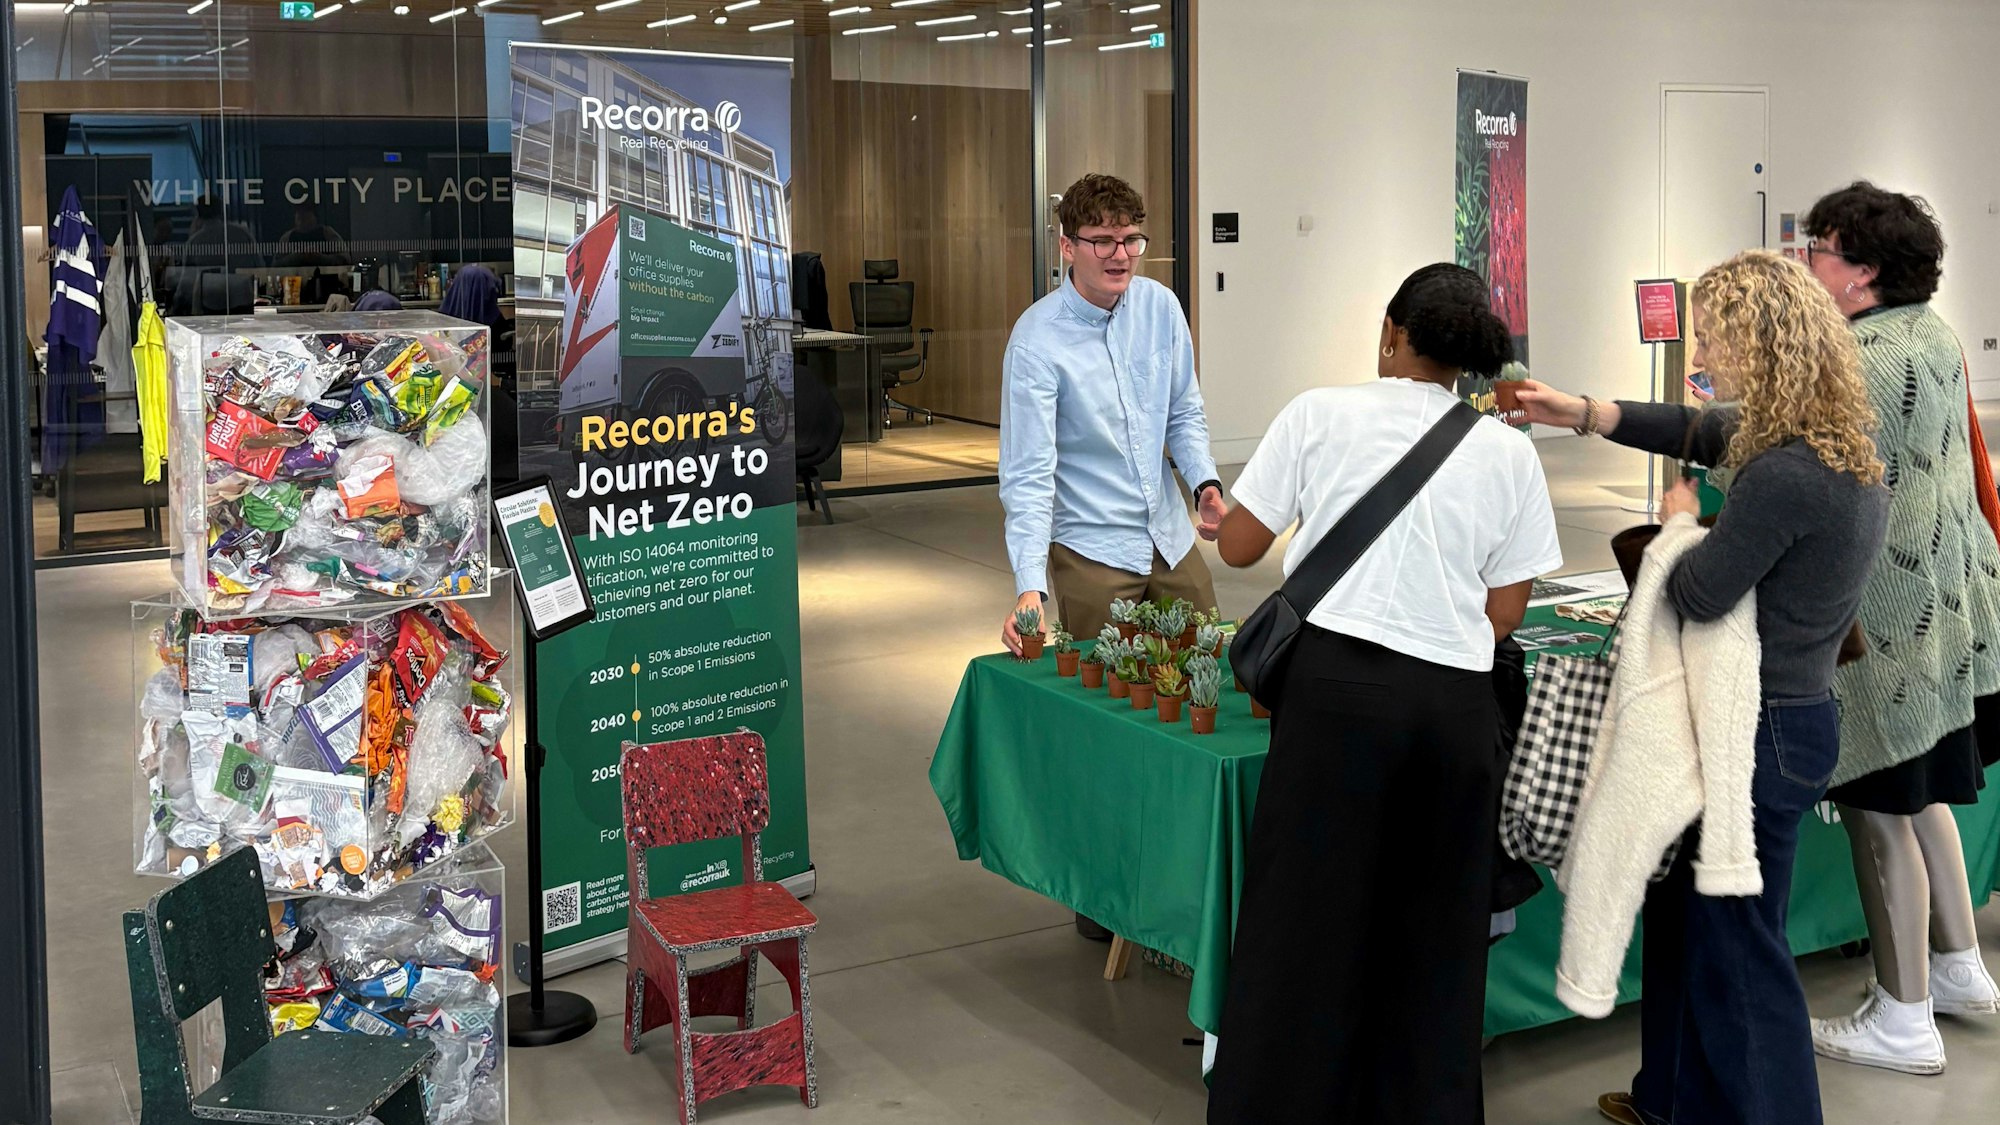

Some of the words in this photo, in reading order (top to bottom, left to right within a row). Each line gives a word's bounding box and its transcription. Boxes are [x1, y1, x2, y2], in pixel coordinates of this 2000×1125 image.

[581, 96, 709, 131] Recorra
[1475, 108, 1509, 135] Recorra
[620, 135, 645, 148] Real
[650, 136, 708, 151] Recycling
[133, 178, 264, 205] WHITE
[284, 177, 374, 204] CITY
[393, 176, 511, 203] PLACE
[628, 249, 652, 267] We'll
[654, 257, 684, 273] deliver
[686, 266, 704, 278] your
[689, 239, 726, 261] Recorra
[628, 265, 657, 281] office
[658, 272, 695, 289] supplies
[628, 280, 667, 297] without
[669, 286, 685, 299] the
[686, 291, 715, 305] carbon
[630, 313, 640, 323] big
[640, 315, 660, 324] impact
[208, 410, 228, 445] URBAN
[217, 415, 239, 450] FRUIT
[581, 402, 756, 452] Recorra’s
[566, 452, 721, 499] Journey
[731, 444, 769, 477] to
[500, 504, 518, 513] Circular
[502, 511, 520, 520] Flexible
[519, 505, 537, 514] Plastics
[588, 498, 655, 542] Net
[666, 492, 754, 529] Zero
[583, 552, 616, 571] With
[619, 547, 642, 565] ISO
[645, 540, 685, 560] 14064
[688, 531, 759, 553] monitoring
[650, 559, 686, 577] we're
[689, 546, 759, 571] committed
[761, 546, 775, 559] to
[654, 578, 676, 595] net
[679, 574, 708, 590] zero
[711, 569, 731, 584] for
[733, 566, 755, 580] our
[659, 592, 684, 611] and
[687, 590, 710, 605] our
[713, 582, 756, 603] planet.
[648, 649, 672, 664] 50%
[674, 640, 721, 659] absolute
[722, 631, 772, 650] reduction
[589, 665, 625, 685] 2030
[648, 669, 659, 681] in
[661, 663, 695, 679] Scope
[697, 659, 702, 671] 1
[704, 650, 756, 670] Emissions
[650, 702, 679, 718] 100%
[681, 693, 728, 712] absolute
[730, 683, 778, 702] reduction
[780, 678, 789, 689] in
[590, 712, 627, 733] 2040
[650, 719, 685, 736] Scope
[687, 716, 692, 727] 1
[694, 710, 715, 725] and
[716, 708, 724, 721] 2
[726, 698, 777, 718] Emissions
[600, 827, 622, 843] For
[763, 851, 795, 866] Recycling
[586, 878, 605, 891] Read
[605, 873, 625, 885] more
[586, 887, 607, 900] about
[607, 884, 620, 894] our
[680, 867, 731, 892] @recorrauk
[586, 896, 612, 909] carbon
[586, 904, 616, 918] strategy
